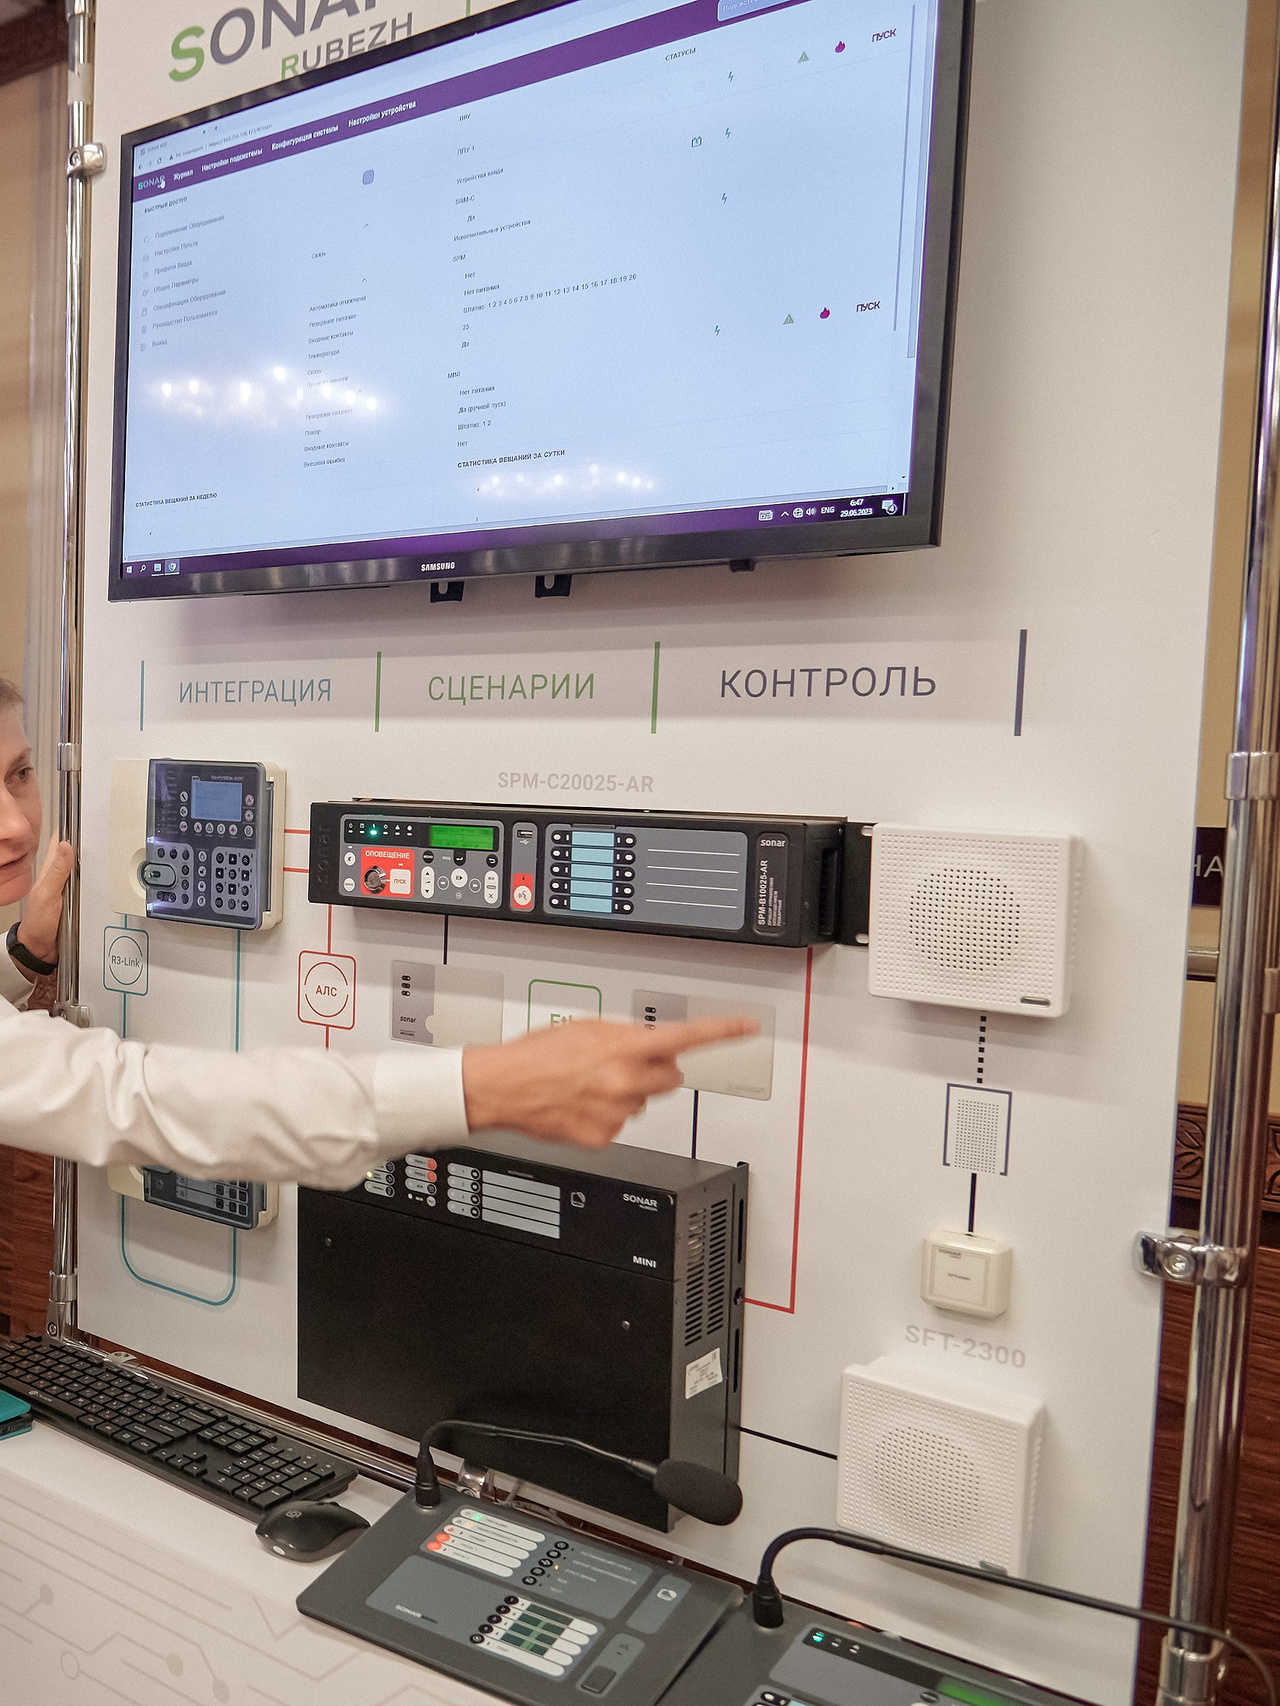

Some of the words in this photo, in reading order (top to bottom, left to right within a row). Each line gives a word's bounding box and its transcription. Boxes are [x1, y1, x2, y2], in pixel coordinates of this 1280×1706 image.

[168, 0, 376, 83] SONA
[871, 28, 897, 43] ПУСК
[281, 12, 413, 81] RUBEZH
[665, 46, 697, 61] СТАТУСЫ
[173, 169, 193, 182] Журнал
[201, 156, 229, 173] Настройки
[229, 148, 263, 165] подсистемы
[271, 131, 312, 151] Конфигурация
[312, 124, 339, 140] системы
[348, 111, 381, 128] Настройки
[381, 101, 417, 119] устройства
[168, 196, 188, 208] ДОСТУП
[600, 279, 608, 287] 17
[609, 277, 618, 285] 18
[619, 275, 627, 283] 19
[628, 273, 637, 281] 20
[855, 300, 880, 313] ПУСК
[457, 458, 497, 469] СТАТИСТИКА
[498, 453, 532, 465] ВЕЩАНИЙ
[532, 452, 542, 460] ЗА
[543, 449, 566, 459] СУТКИ
[135, 499, 165, 508] СТАТИСТИКА
[164, 495, 189, 505] ВЕЩАНИЙ
[196, 492, 218, 501] НЕДЕЛЮ
[849, 498, 864, 507] 6:47
[820, 506, 836, 514] ENG
[421, 561, 456, 573] SAMSUNG
[718, 664, 938, 698] КОНТРОЛЬ
[178, 676, 332, 706] ИНТЕГРАЦИЯ
[426, 672, 595, 706] СЦЕНАРИИ
[498, 771, 655, 793] SPM-C20025-AR
[760, 839, 786, 848] sonar
[365, 850, 411, 860] ОПОВЕЩЕНИЕ
[111, 955, 141, 970] R3-Link
[315, 984, 338, 998] АЛС
[622, 1193, 658, 1208] SONAR
[632, 1255, 657, 1269] MINI
[905, 1324, 1026, 1369] SFT-2300
